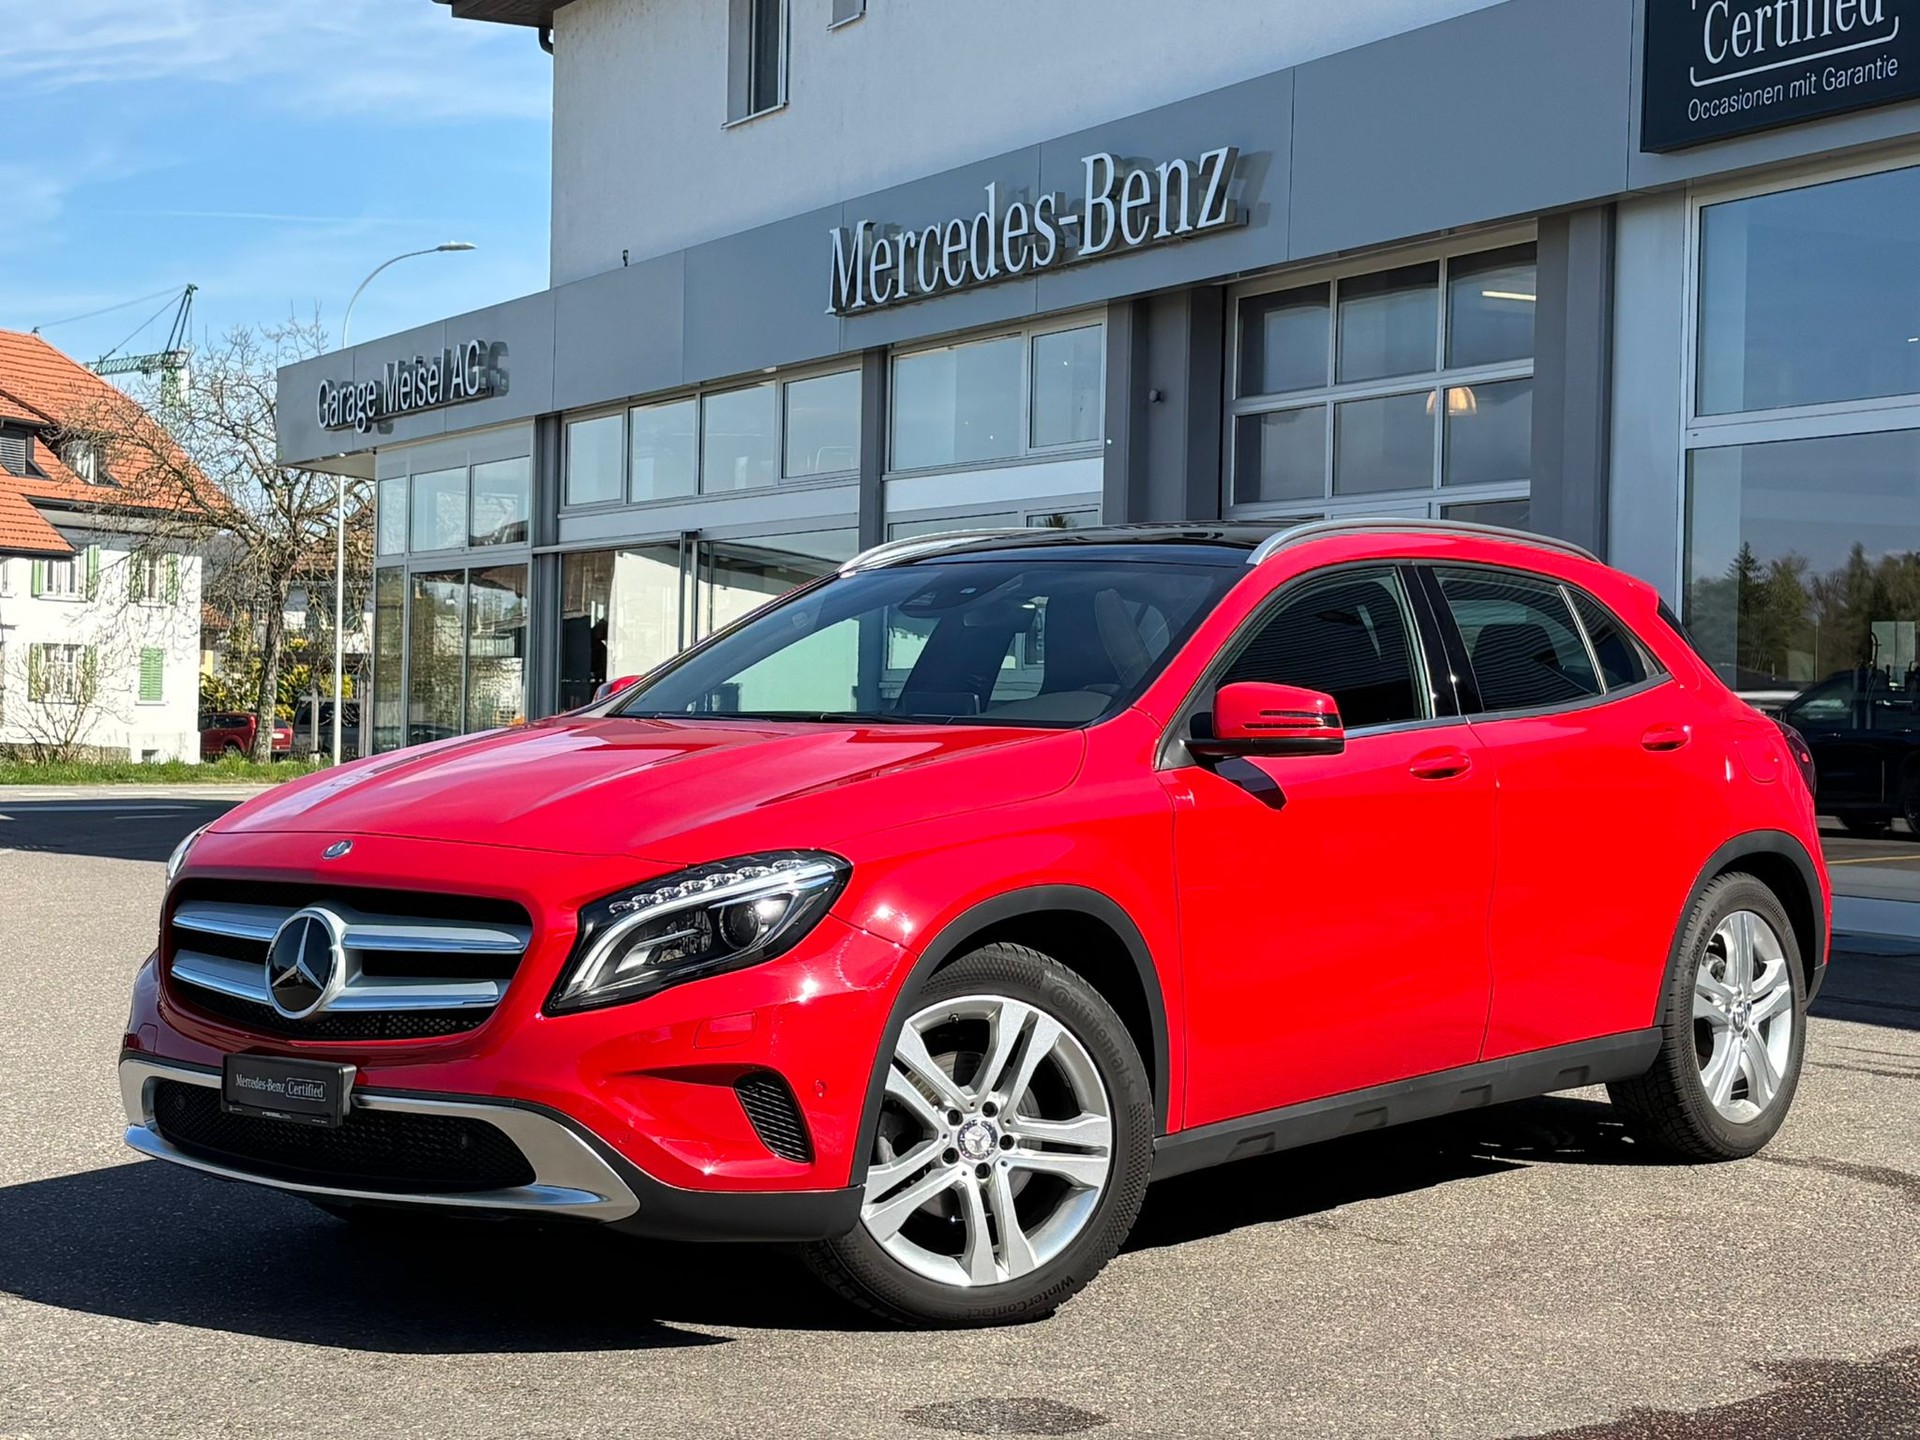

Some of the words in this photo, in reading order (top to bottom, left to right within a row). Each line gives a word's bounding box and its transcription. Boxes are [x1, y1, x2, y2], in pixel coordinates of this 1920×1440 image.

[1688, 83, 1783, 122] Occasionen
[1789, 72, 1816, 99] mit
[1822, 54, 1898, 91] Garantie
[825, 146, 1235, 315] Mercedes-Benz
[317, 378, 377, 433] Garage
[382, 347, 445, 414] Meisel
[450, 339, 480, 399] AG
[235, 1074, 286, 1093] Mercedes-Benz
[288, 1081, 324, 1098] Certified
[967, 1275, 1075, 1318] WinterContact
